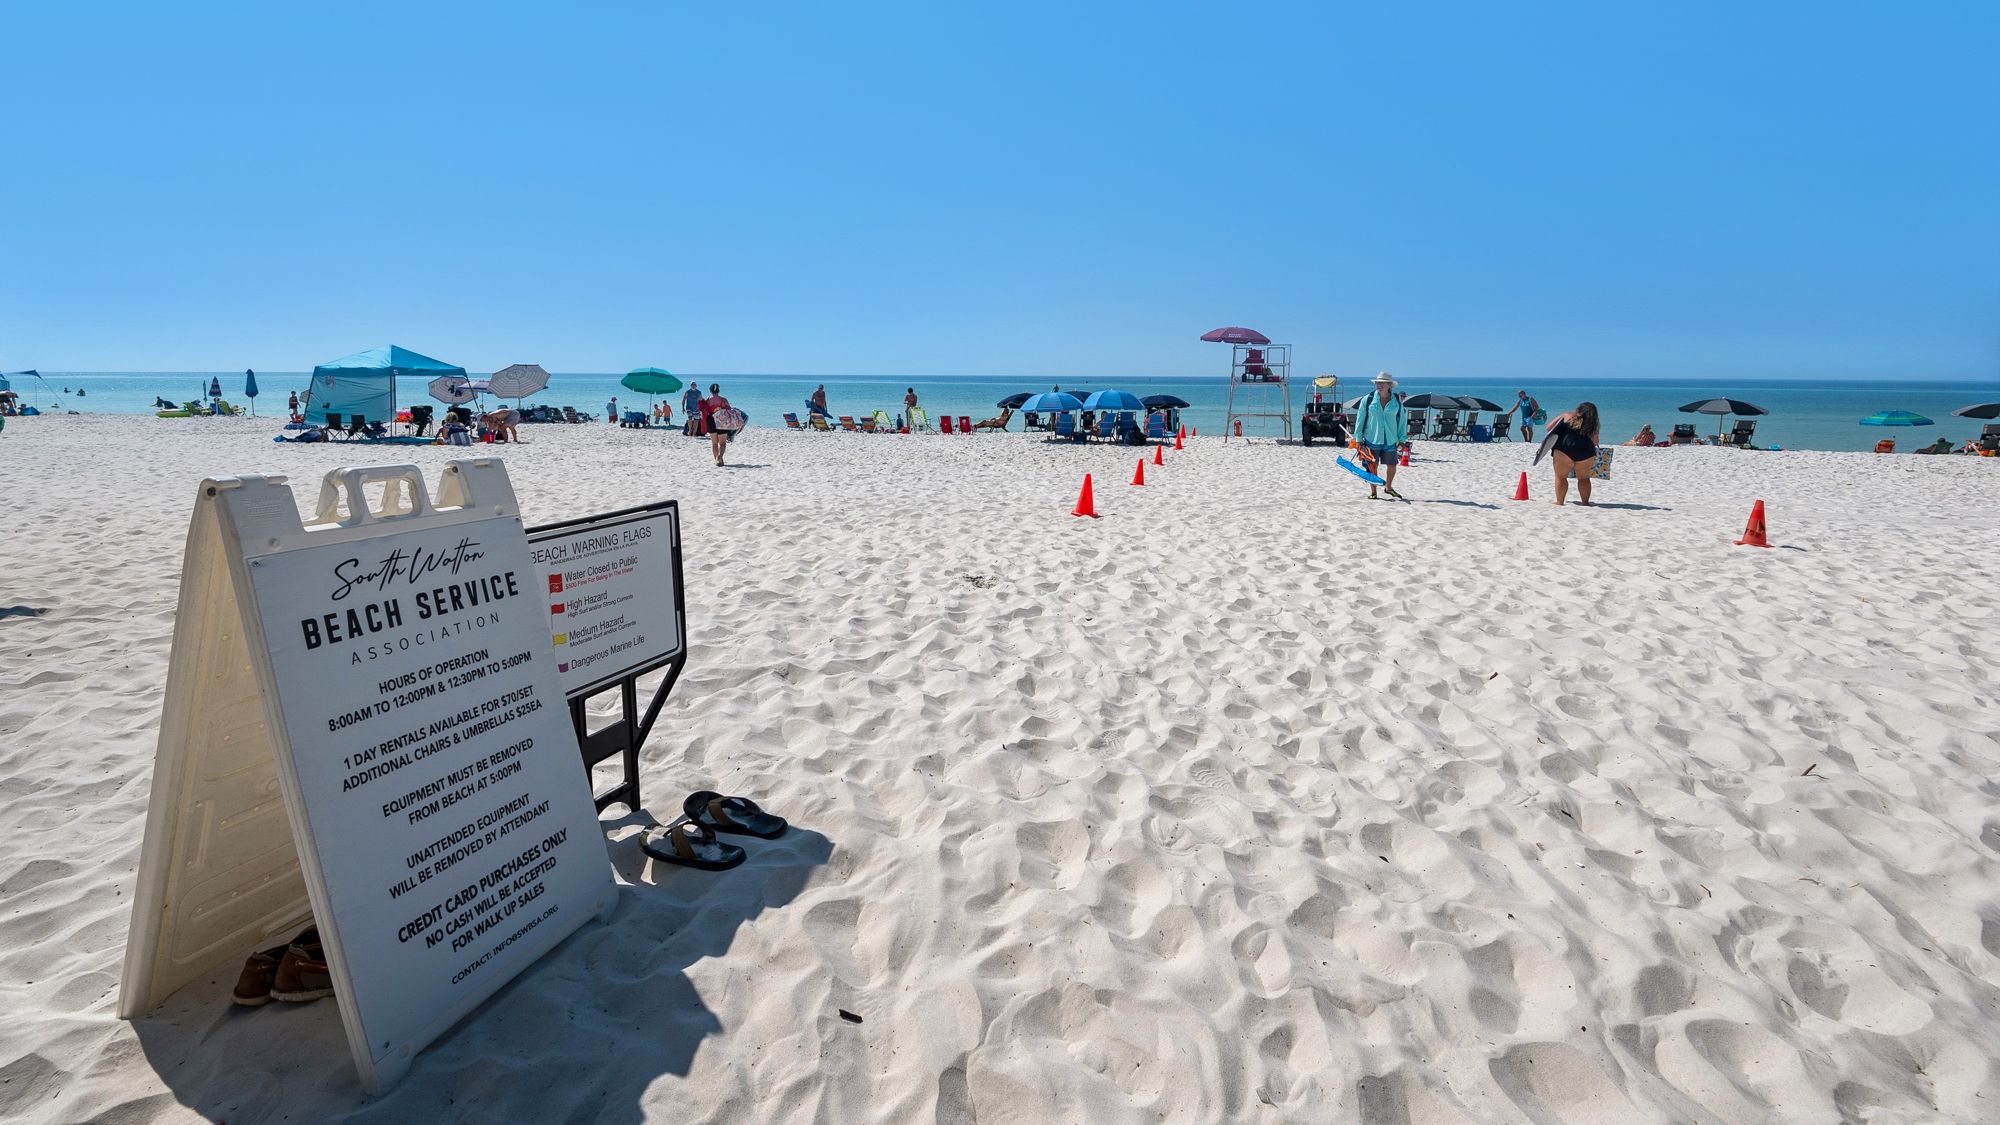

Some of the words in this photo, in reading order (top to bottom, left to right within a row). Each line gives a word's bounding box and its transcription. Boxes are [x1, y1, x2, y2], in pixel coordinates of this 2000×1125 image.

[332, 549, 410, 600] South
[409, 537, 484, 584] Walton
[565, 569, 586, 582] Water
[587, 562, 610, 576] Closed
[611, 562, 618, 570] to
[619, 555, 638, 568] Public
[572, 533, 619, 554] WARNING
[623, 526, 652, 542] FLAGS
[301, 599, 402, 650] BEACH
[416, 571, 519, 619] SERVICE
[565, 582, 577, 590] $500
[577, 579, 587, 587] Fine
[566, 599, 582, 611] High
[584, 590, 608, 605] Hazard
[568, 609, 578, 619] High
[578, 607, 588, 615] Surf
[352, 612, 499, 665] ASSOCIATION
[569, 625, 598, 641] Medium
[600, 614, 624, 630] Hazard
[571, 650, 609, 669] Dangerous
[610, 640, 632, 655] Marine
[633, 635, 645, 646] Life
[328, 706, 372, 731] 8:00AM
[374, 700, 390, 715] TO
[393, 684, 436, 708] 12:00PM
[438, 681, 446, 692] &
[448, 667, 486, 688] 12:30PM
[487, 662, 500, 674] TO
[502, 651, 532, 669] 5:00PM
[379, 672, 416, 694] HOURS
[419, 667, 432, 680] OF
[435, 649, 489, 675] OPERATION
[343, 753, 413, 792] ADDITIONAL
[414, 736, 452, 760] CHAIRS
[453, 733, 461, 744] &
[462, 709, 515, 740] UMBRELLAS
[516, 699, 542, 718] $25EA
[344, 757, 351, 770] 1
[354, 746, 376, 766] DAY
[380, 727, 427, 755] RENTALS
[429, 706, 480, 737] AVAILABLE
[481, 699, 500, 714] FOR
[501, 685, 533, 707] $70/SET
[382, 778, 445, 818] EQUIPMENT
[447, 764, 474, 787] MUST
[476, 758, 489, 772] BE
[490, 738, 534, 766] REMOVED
[408, 803, 440, 825] FROM
[441, 783, 476, 809] BEACH
[477, 776, 488, 793] AT
[490, 760, 522, 785] 5:00PM
[388, 876, 418, 899] WILL
[418, 867, 433, 884] BE
[434, 838, 484, 874] REMOVED
[485, 829, 497, 845] BY
[500, 800, 551, 838] ATTENDANT
[406, 823, 476, 869] UNATTENDED
[477, 793, 530, 830] EQUIPMENT
[398, 904, 442, 943] CREDIT
[445, 884, 478, 913] CARD
[479, 844, 541, 893] PURCHASES
[542, 828, 568, 853] ONLY
[425, 928, 444, 949] NO
[445, 909, 474, 935] CASH
[474, 894, 498, 917] WILL
[499, 885, 512, 901] BE
[513, 856, 557, 893] ACCEPTED
[451, 930, 474, 953] FOR
[474, 910, 504, 937] WALK
[503, 900, 518, 917] UP
[519, 882, 545, 908] SALES
[451, 952, 493, 985] CONTACT:
[493, 904, 559, 956] INFO@SWBSA.ORG
